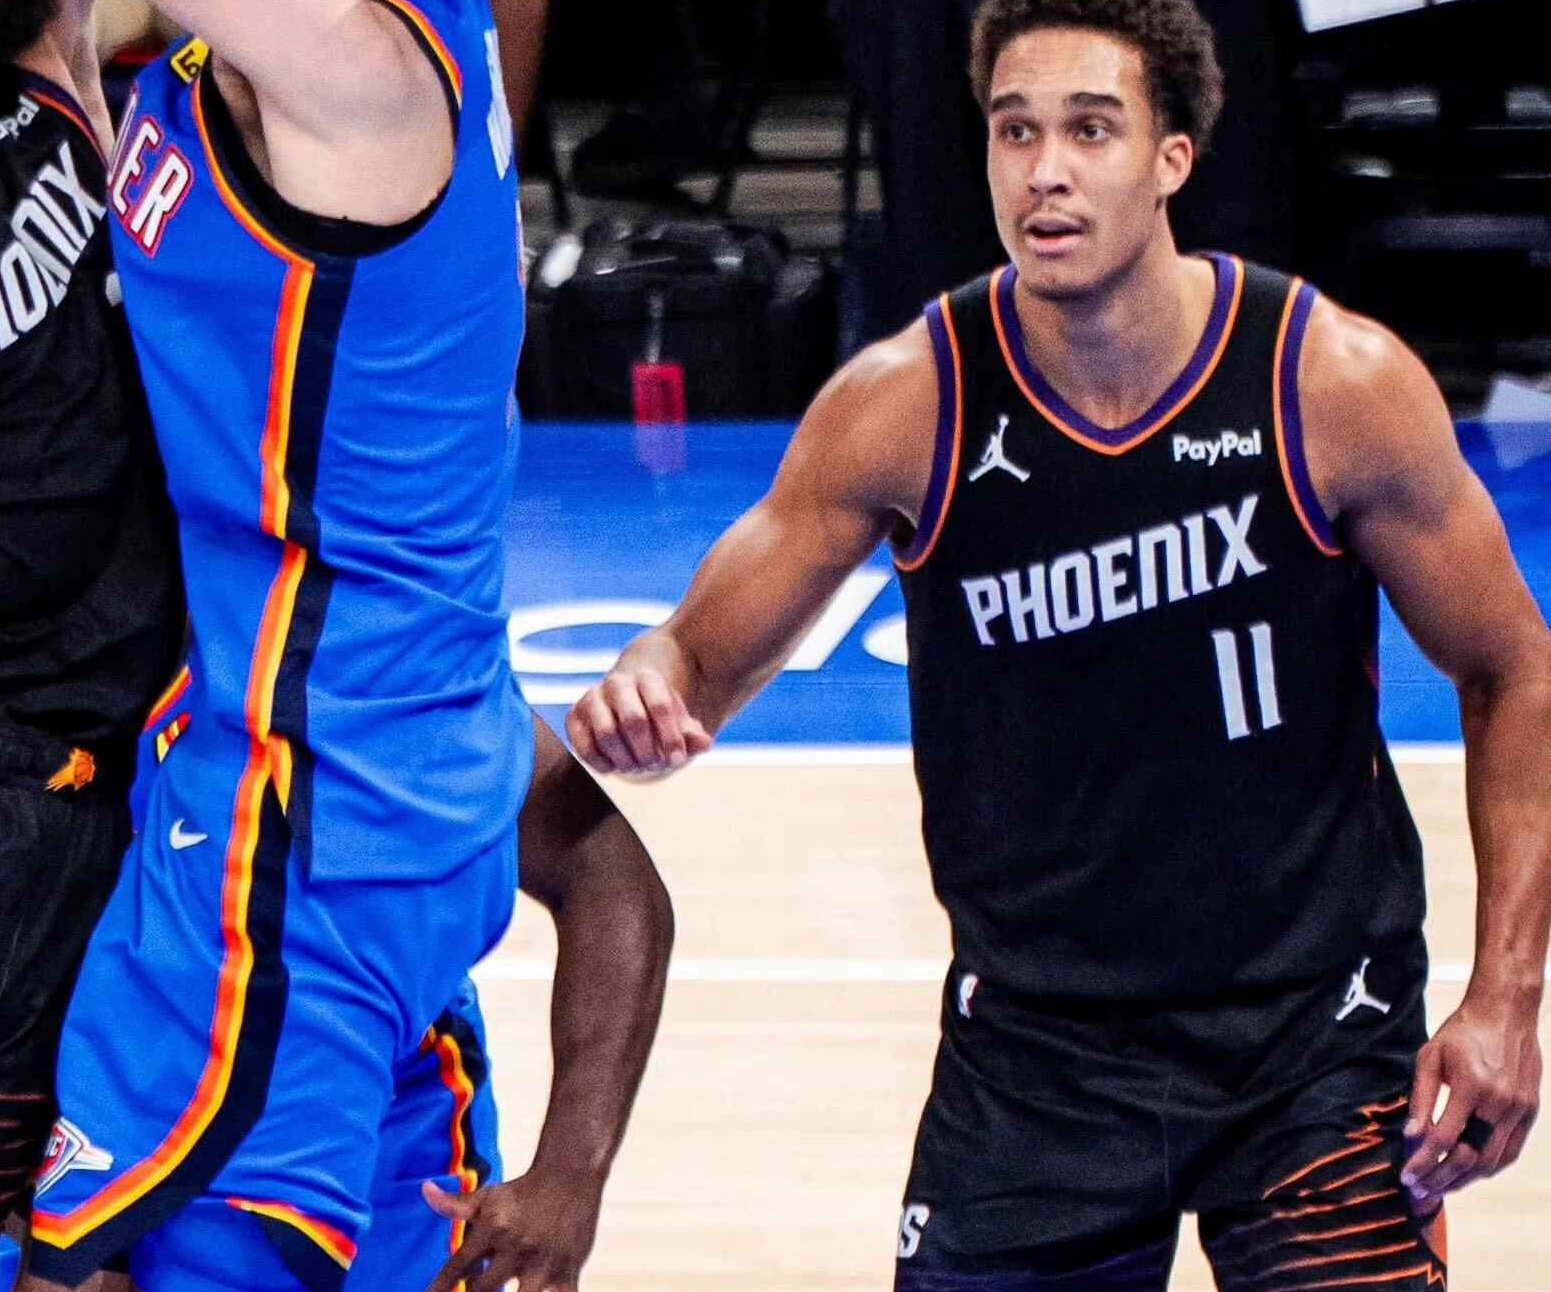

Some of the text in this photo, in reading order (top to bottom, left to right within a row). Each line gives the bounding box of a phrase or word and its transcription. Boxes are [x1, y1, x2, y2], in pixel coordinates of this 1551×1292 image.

[1172, 428, 1262, 467] PayPal
[961, 495, 1266, 646] PHOENIX
[1211, 622, 1283, 741] 11
